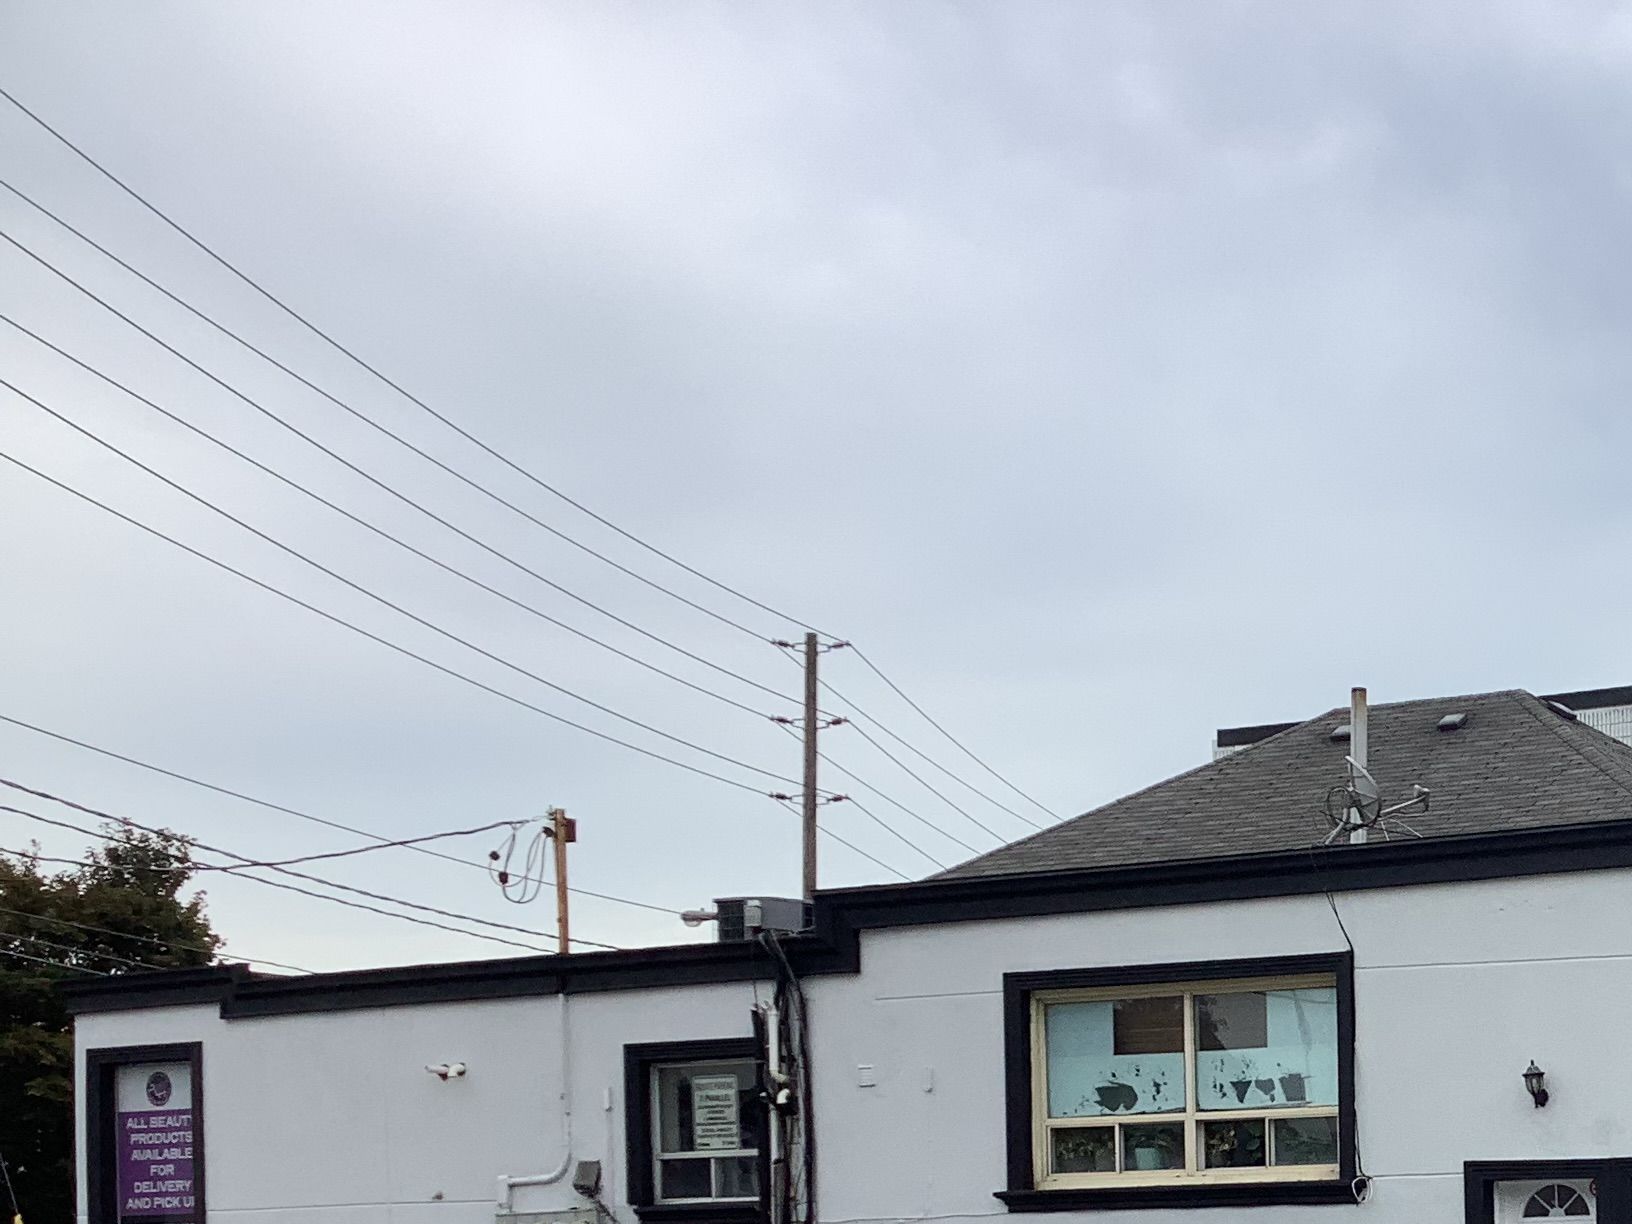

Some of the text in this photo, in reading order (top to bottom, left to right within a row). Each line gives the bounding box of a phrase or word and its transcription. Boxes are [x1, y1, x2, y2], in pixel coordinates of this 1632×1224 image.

[126, 1115, 193, 1129] ALL BEAUT
[130, 1131, 193, 1145] PRODUCTS
[131, 1147, 193, 1160] AVAILABLE
[150, 1164, 175, 1176] FOR
[134, 1180, 193, 1193] DELIVERY
[125, 1195, 195, 1210] AND PICK U
